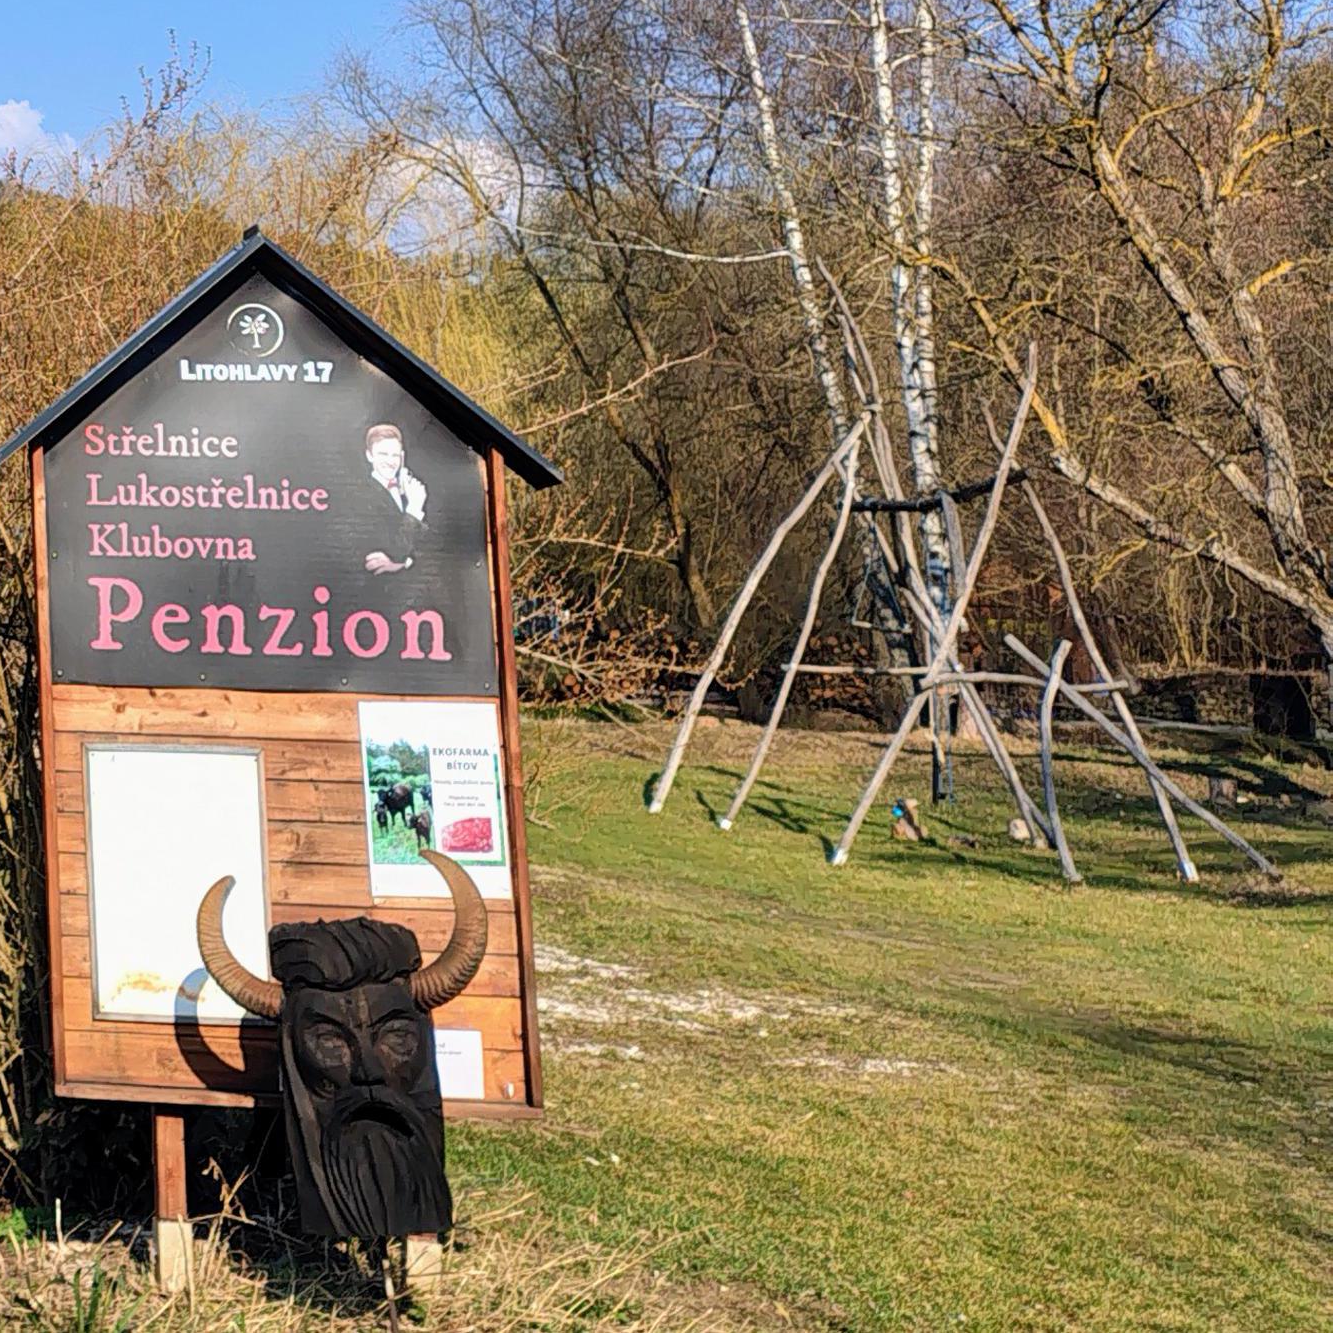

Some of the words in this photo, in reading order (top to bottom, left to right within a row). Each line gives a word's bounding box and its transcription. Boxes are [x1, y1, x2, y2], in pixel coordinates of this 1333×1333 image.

[303, 361, 333, 383] 17
[84, 422, 239, 458] Střelnice
[85, 473, 330, 511] Lukostřelnice
[87, 521, 256, 561] Klubovna
[87, 576, 453, 662] Penzion
[432, 747, 490, 757] EKOFARMA
